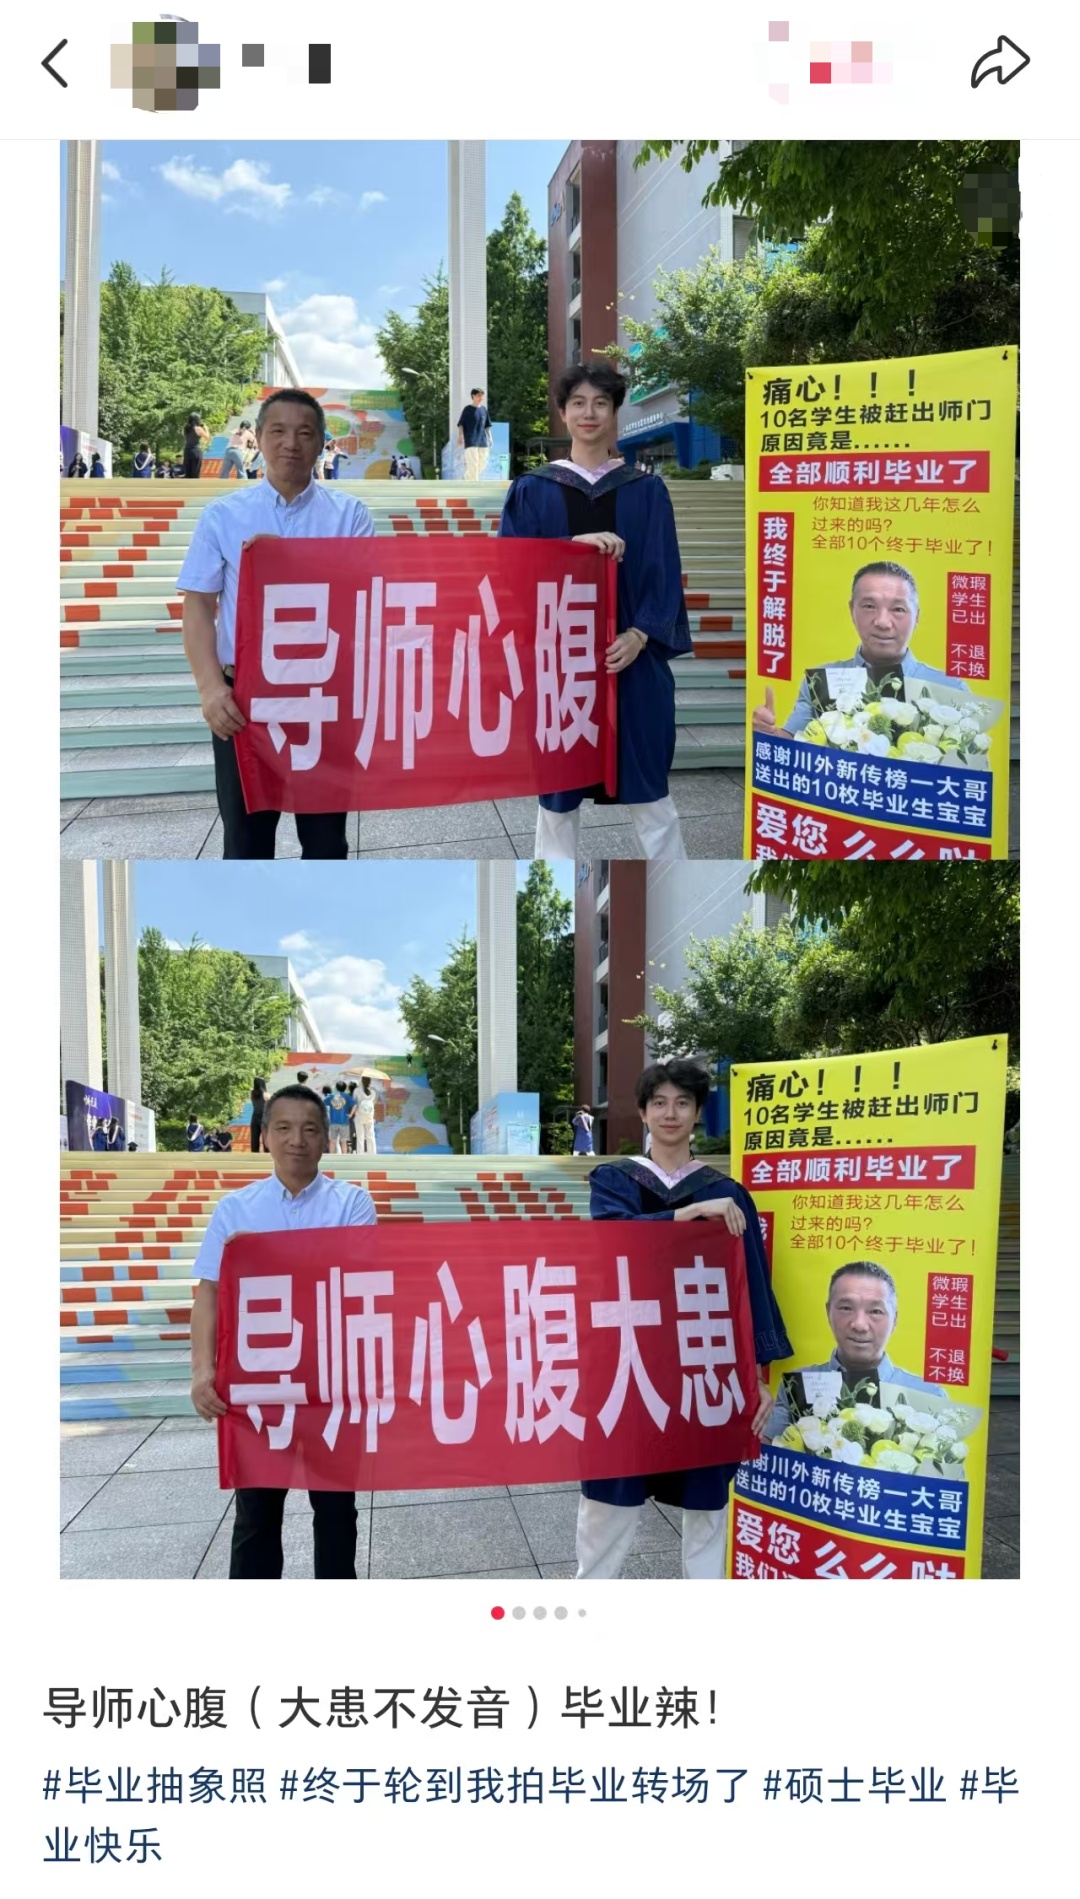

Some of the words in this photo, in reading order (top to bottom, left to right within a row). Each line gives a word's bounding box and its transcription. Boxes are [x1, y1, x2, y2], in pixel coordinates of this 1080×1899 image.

[762, 369, 916, 406] 痛心！！！
[760, 399, 991, 429] 10名学生被赶出师门
[769, 459, 977, 486] 全部顺利毕业了
[812, 496, 981, 513] 你知道我这几年怎么
[812, 517, 893, 533] 过来的吗？
[811, 535, 993, 556] 全部10个终于毕业了！
[951, 574, 987, 591] 微瑕
[762, 516, 788, 674] 我终于解脱了
[951, 591, 987, 608] 学生
[952, 609, 986, 625] 已出
[950, 643, 987, 660] 不退
[250, 574, 600, 771] 导师心腹
[950, 660, 986, 678] 不换
[755, 742, 987, 802] 感谢川外新传榜一大哥
[755, 763, 987, 828] 送出的10枚毕业生宝宝
[746, 1061, 901, 1103] 痛心！！！
[743, 1091, 979, 1126] 10名学生被赶出师门
[751, 1155, 962, 1184] 全部顺利毕业了
[791, 1194, 965, 1211] 你知道我这几年怎么
[790, 1216, 873, 1232] 过来的吗？
[790, 1234, 976, 1256] 全部10个终于毕业了！
[932, 1276, 968, 1293] 微瑕
[931, 1293, 969, 1310] 学生
[931, 1311, 967, 1328] 已出
[229, 1255, 745, 1453] 导师心腹大患
[929, 1347, 965, 1365] 不退
[928, 1365, 965, 1383] 不换
[736, 1468, 961, 1540] 送出的10枚毕业生宝宝
